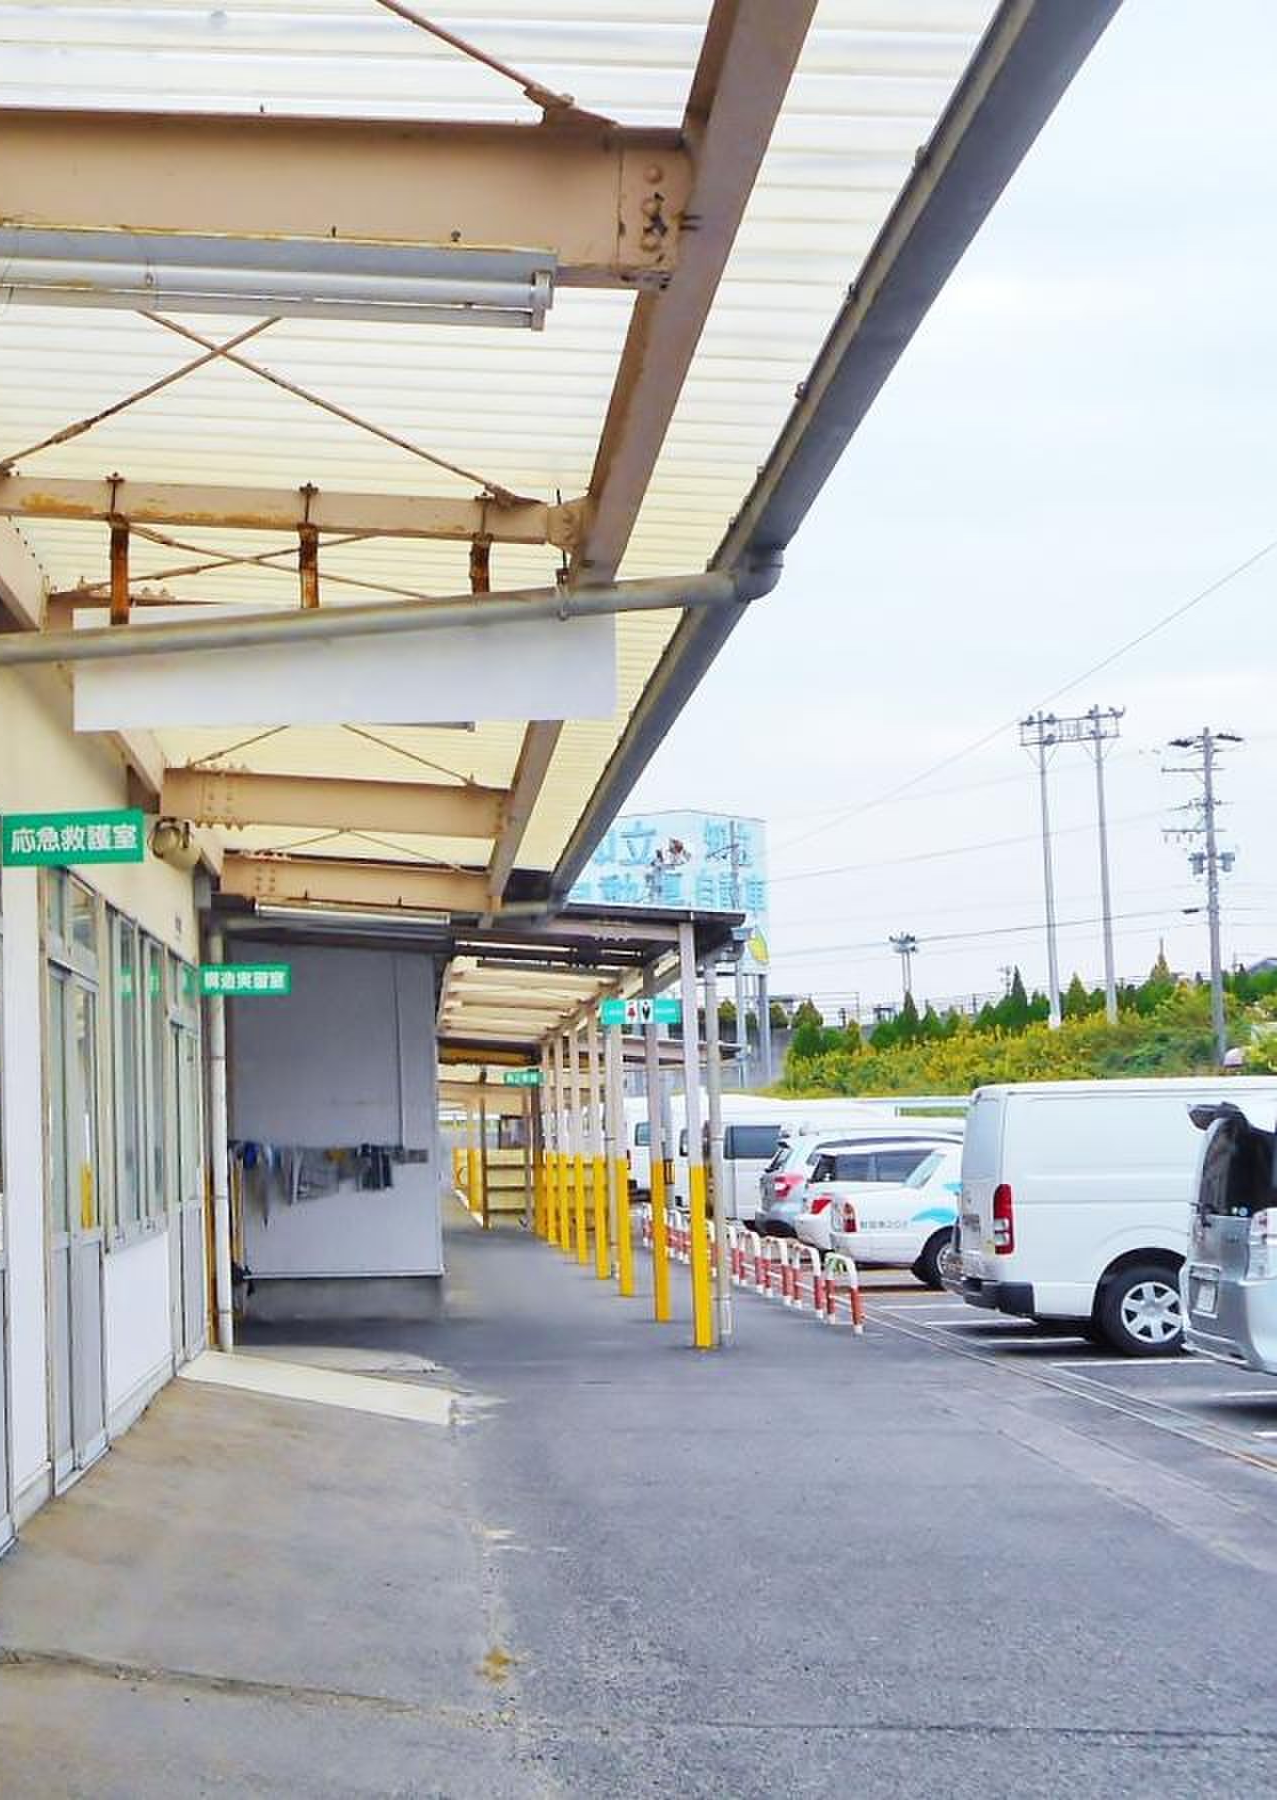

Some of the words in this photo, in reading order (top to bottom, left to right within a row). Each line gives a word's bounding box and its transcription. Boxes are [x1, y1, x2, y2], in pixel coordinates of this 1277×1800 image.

[10, 824, 139, 854] 応急救護室
